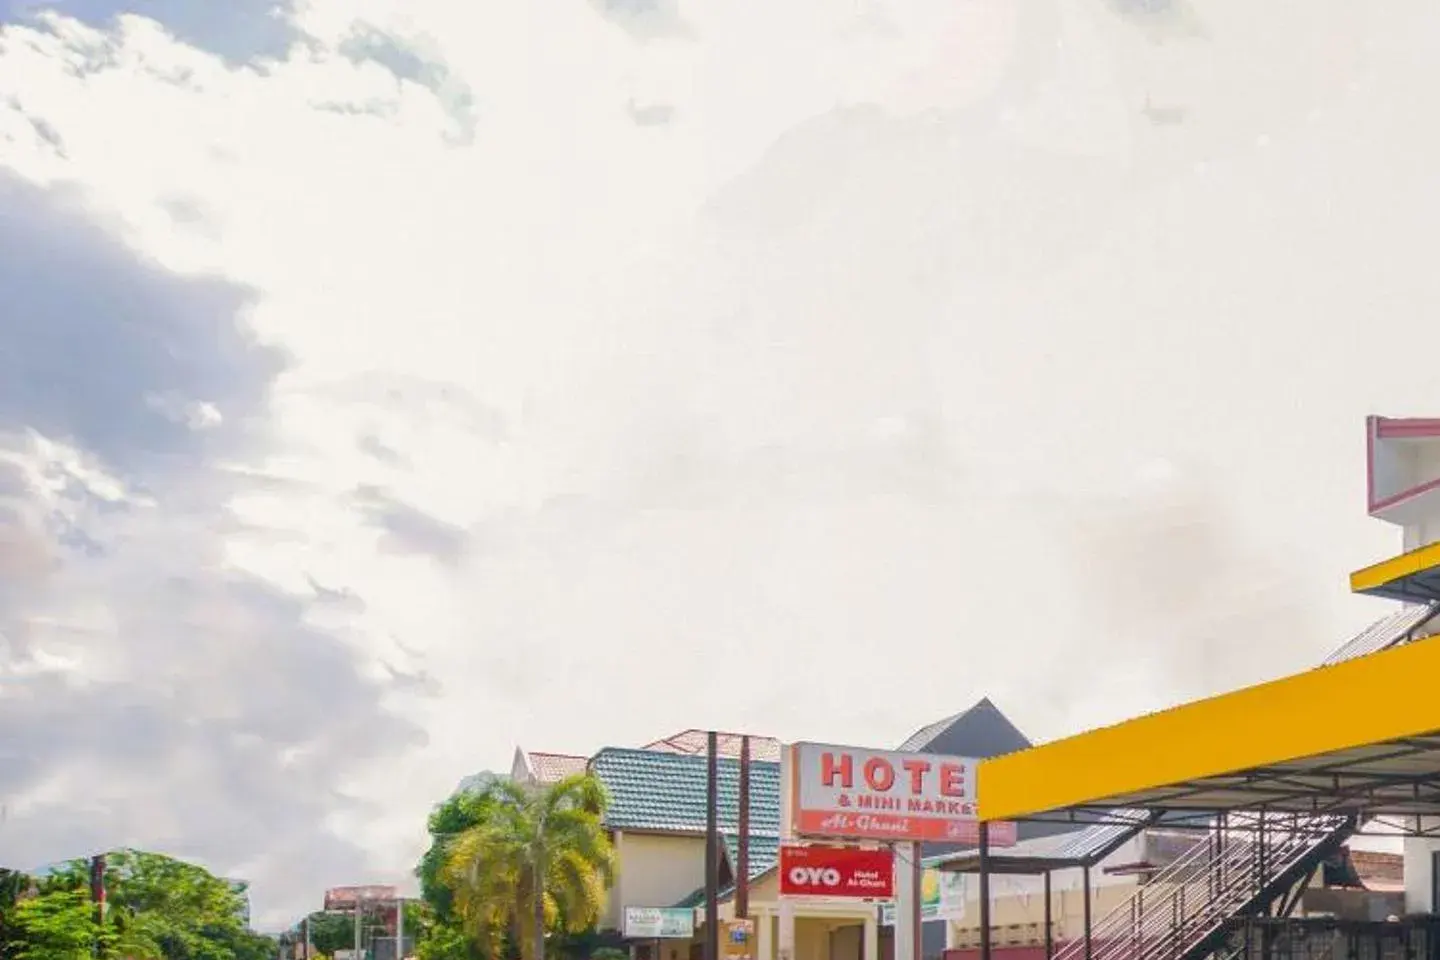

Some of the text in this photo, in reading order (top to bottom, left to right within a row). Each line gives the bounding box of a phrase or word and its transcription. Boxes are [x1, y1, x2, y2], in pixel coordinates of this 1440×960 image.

[820, 752, 966, 798] HOTE
[838, 795, 851, 808] &
[858, 796, 901, 811] MINI
[789, 866, 840, 886] OYO
